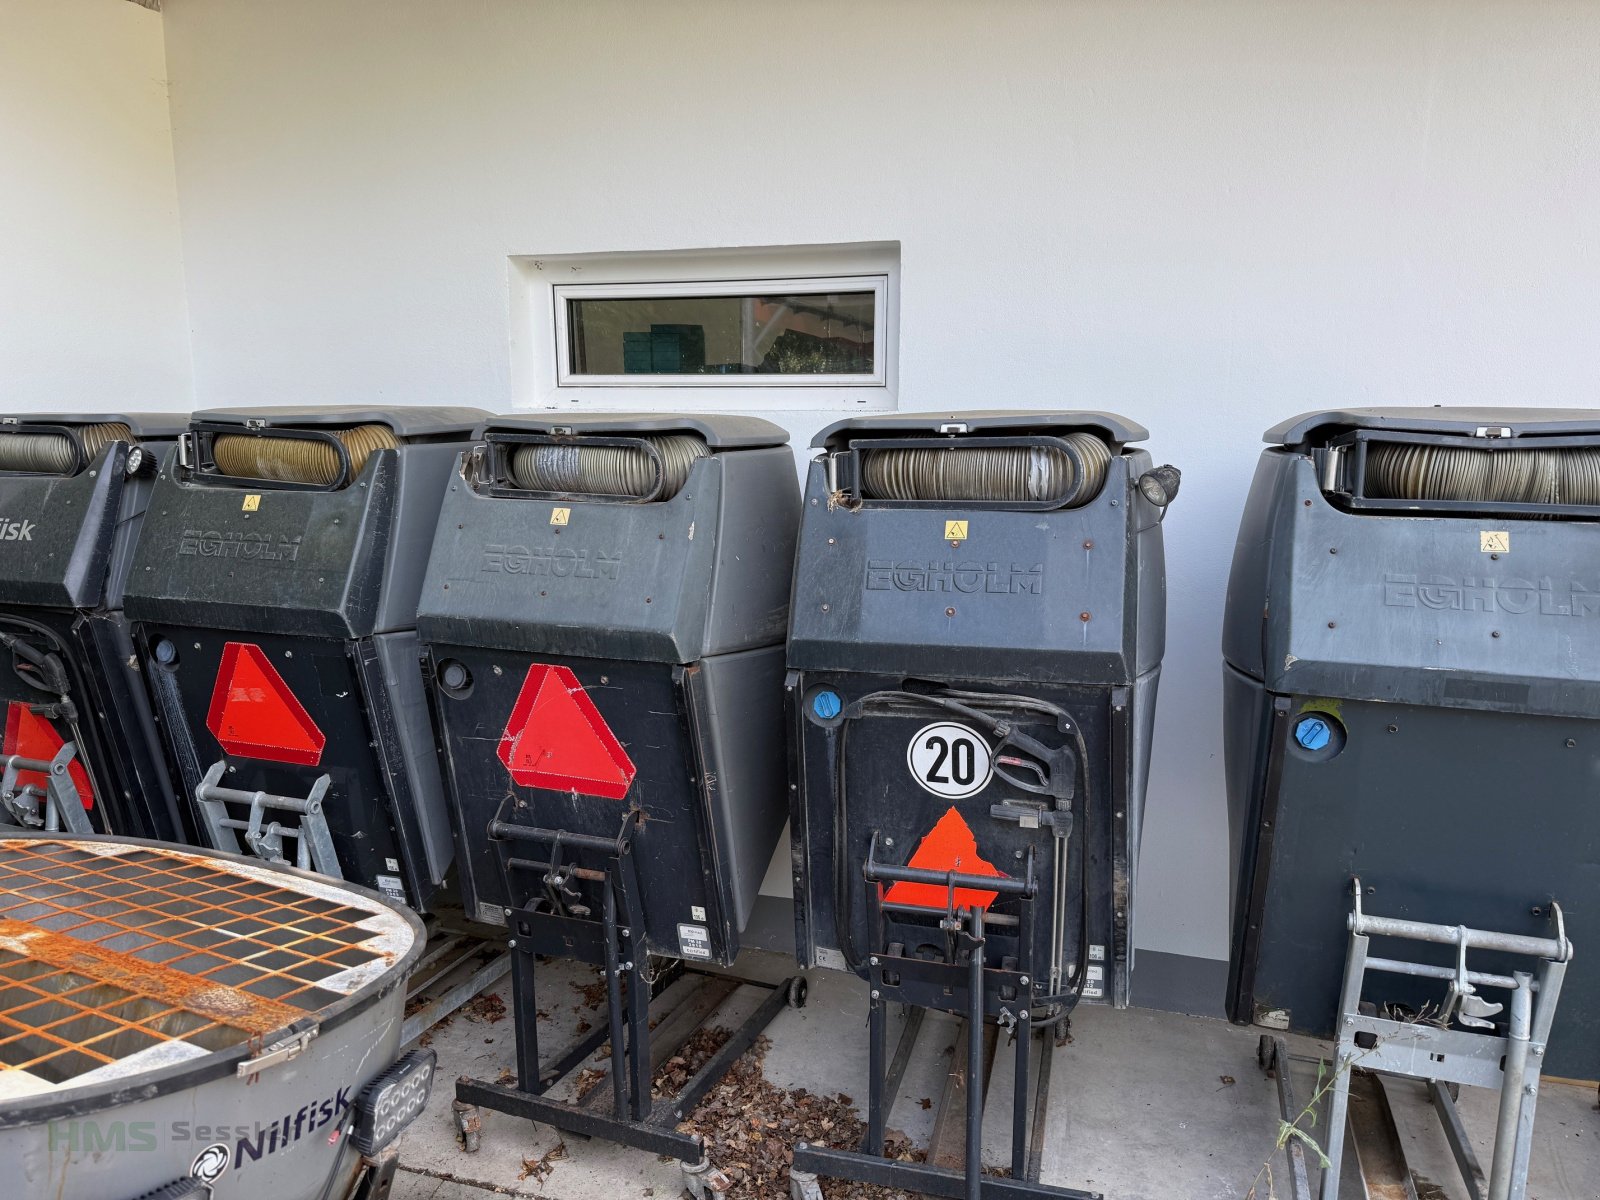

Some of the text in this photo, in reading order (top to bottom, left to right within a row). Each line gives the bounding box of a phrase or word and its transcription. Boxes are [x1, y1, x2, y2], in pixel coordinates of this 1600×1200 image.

[177, 529, 303, 562] EGHOLM
[481, 543, 623, 580] EGHOLM
[865, 559, 1043, 595] EGHOLM
[925, 736, 975, 786] 20
[234, 1085, 352, 1169] Nilfisk
